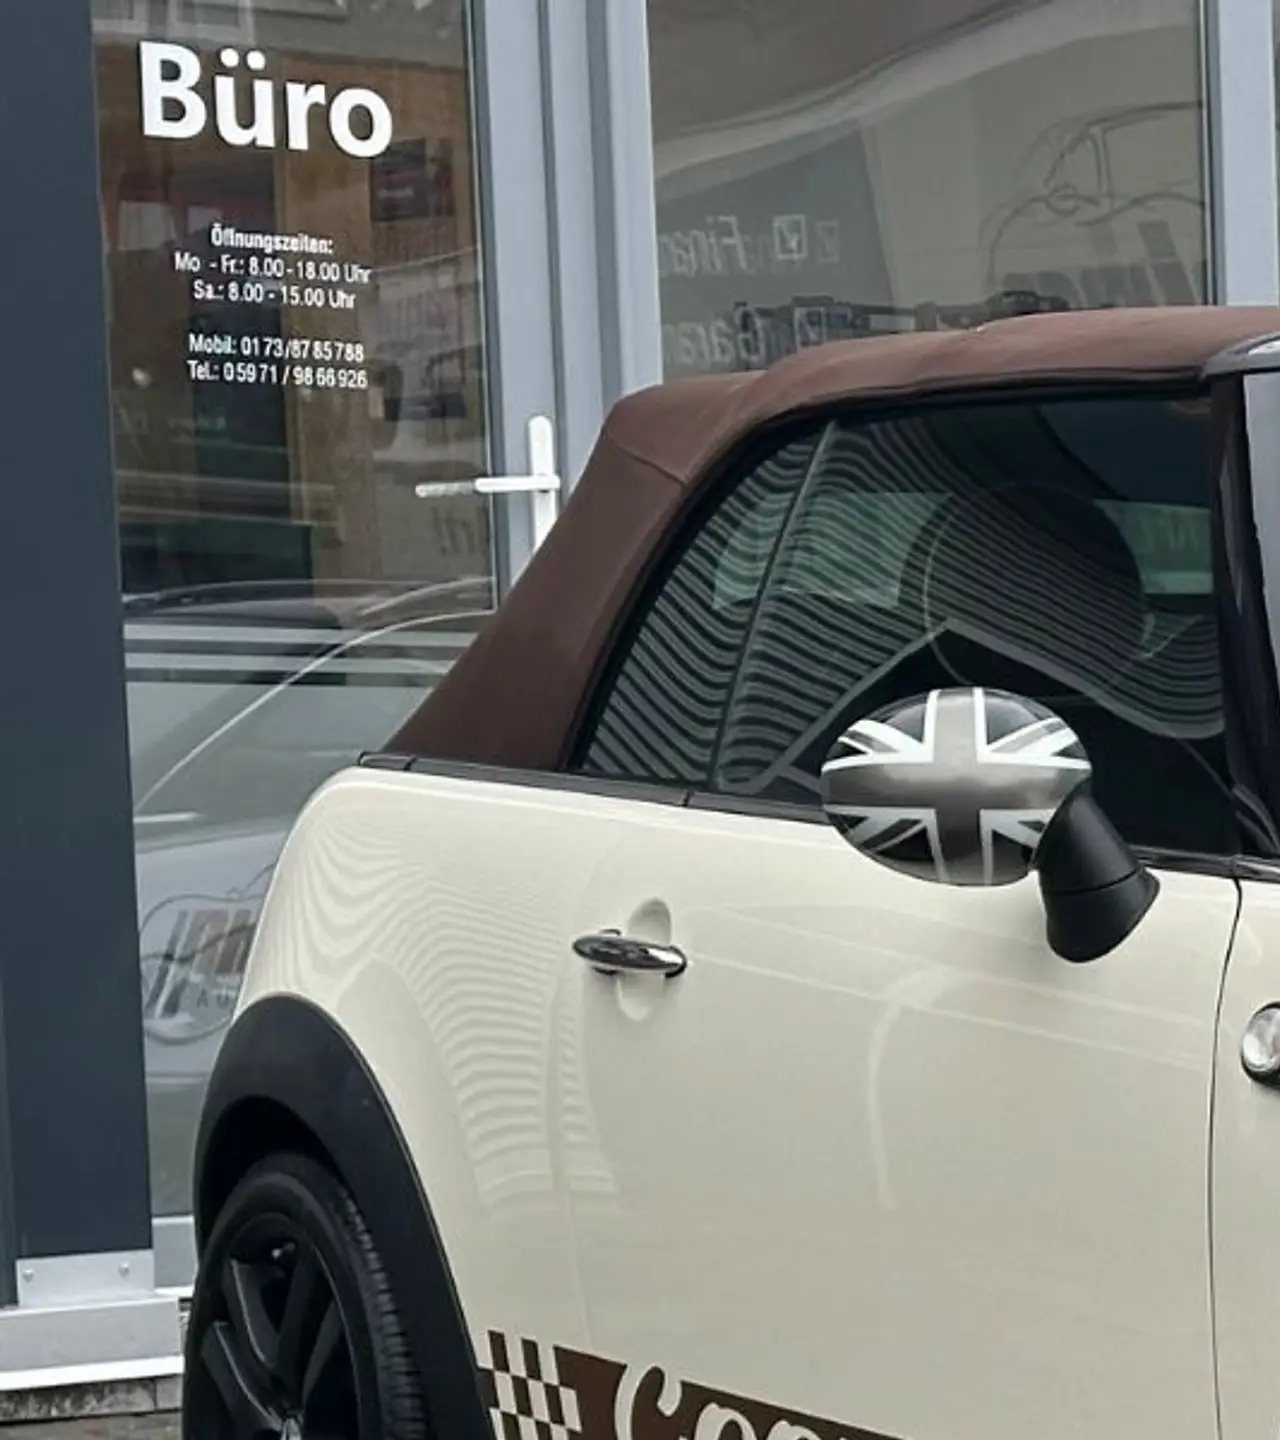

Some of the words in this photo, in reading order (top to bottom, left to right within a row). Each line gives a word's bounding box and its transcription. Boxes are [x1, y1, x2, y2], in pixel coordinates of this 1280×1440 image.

[139, 40, 393, 158] Büro
[211, 222, 335, 254] Öffnungszeiten:
[248, 256, 285, 278] 8.00
[296, 260, 341, 281] 18.00
[344, 263, 373, 283] Uhr
[228, 281, 264, 303] 8.00
[280, 284, 325, 307] 15.00
[328, 288, 356, 309] Uhr
[188, 333, 237, 355] Mobil:
